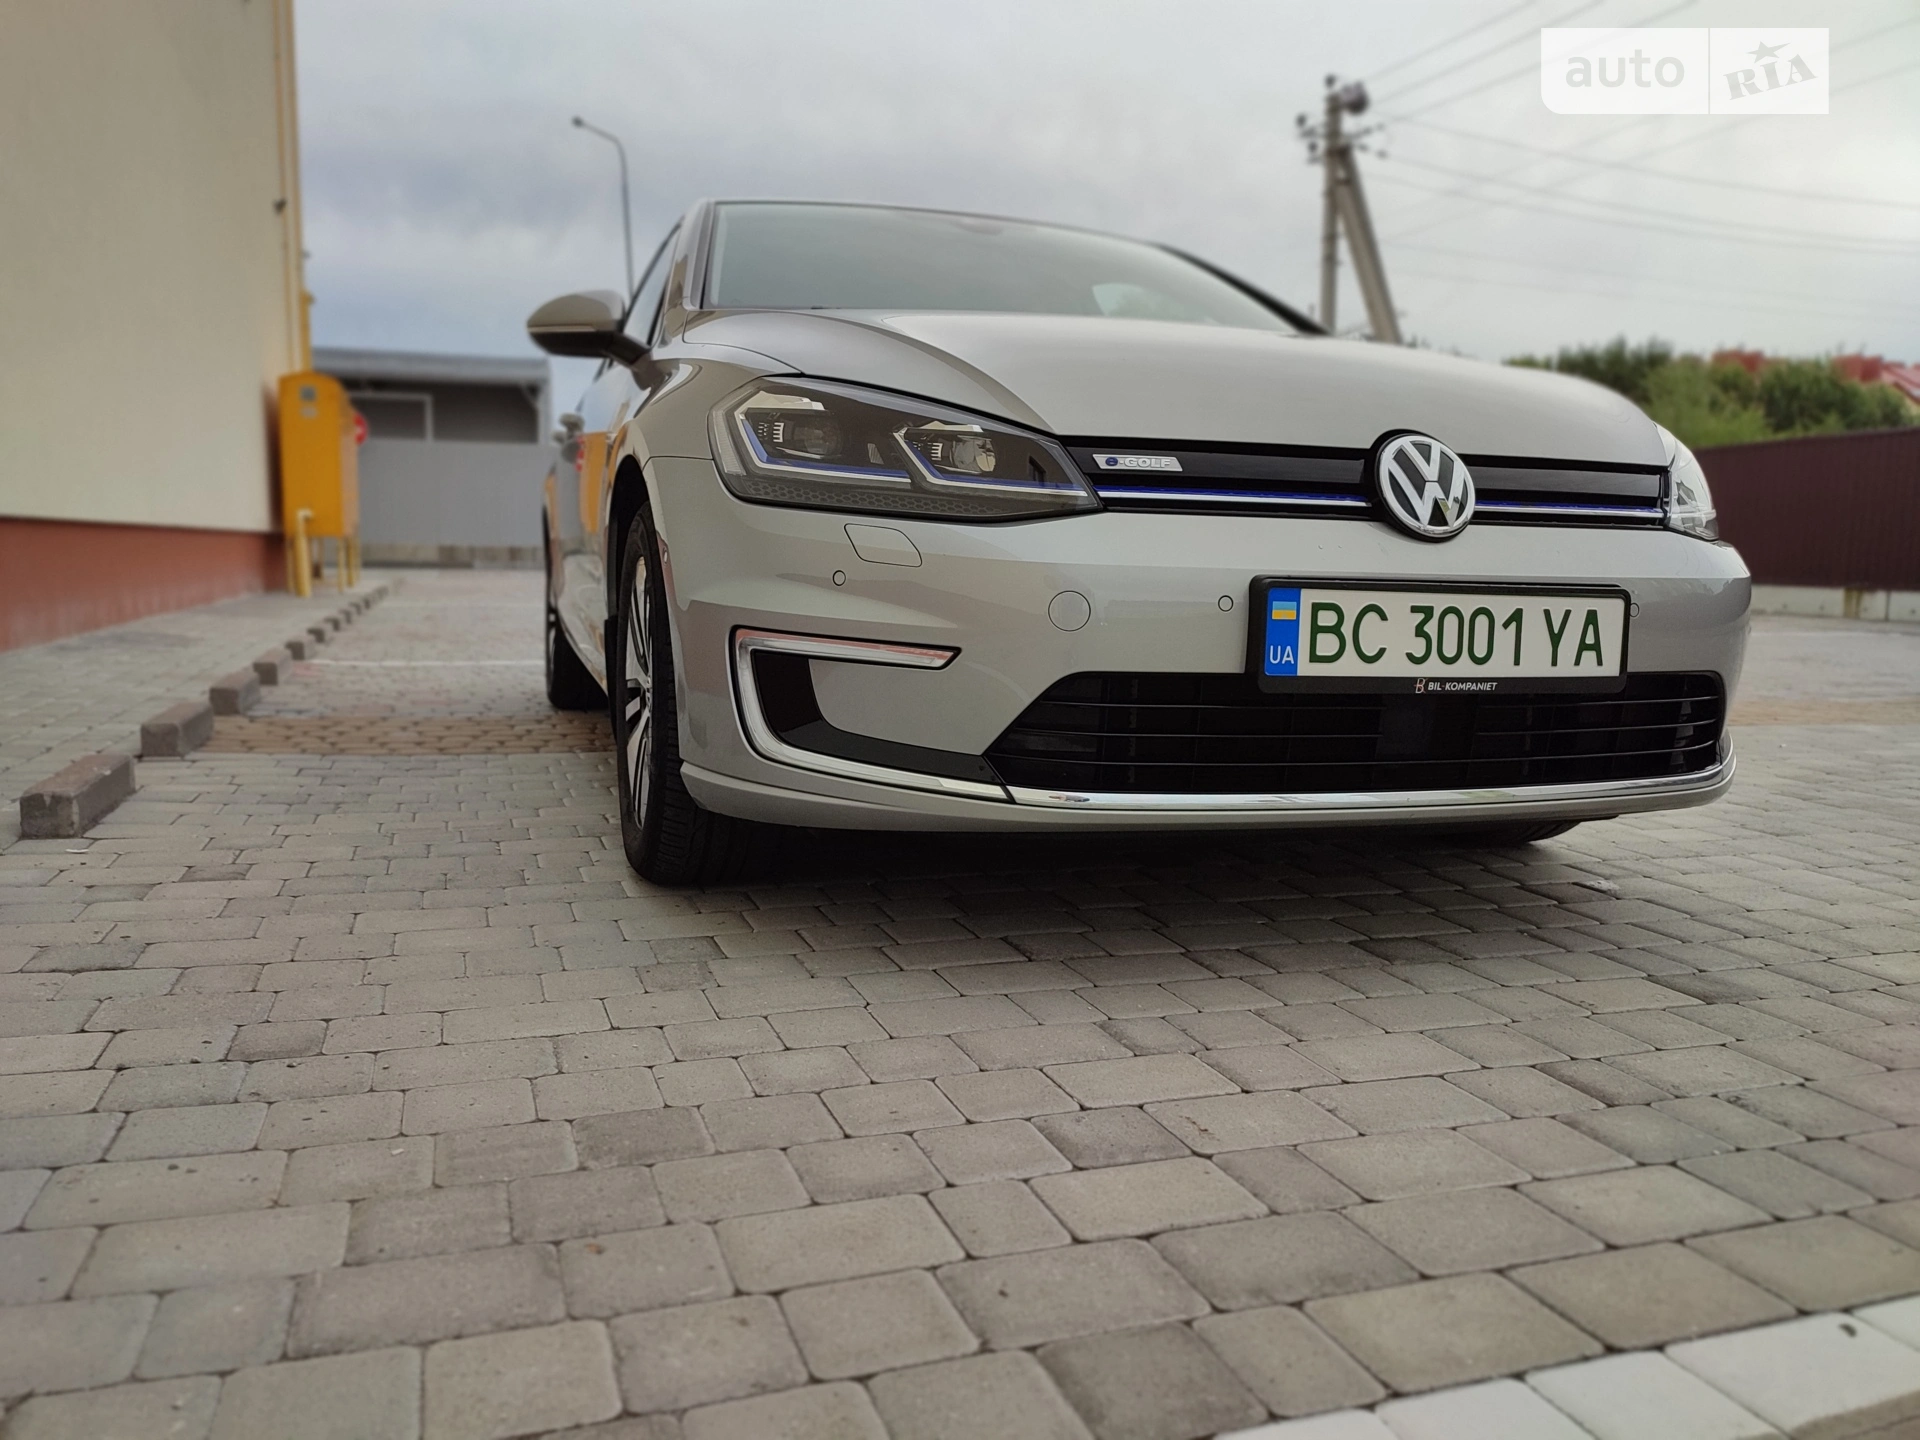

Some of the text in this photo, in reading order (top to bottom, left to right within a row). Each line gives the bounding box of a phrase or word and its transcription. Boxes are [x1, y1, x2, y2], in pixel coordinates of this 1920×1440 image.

[1269, 645, 1294, 665] UA
[1308, 601, 1603, 667] BC 3001 YA
